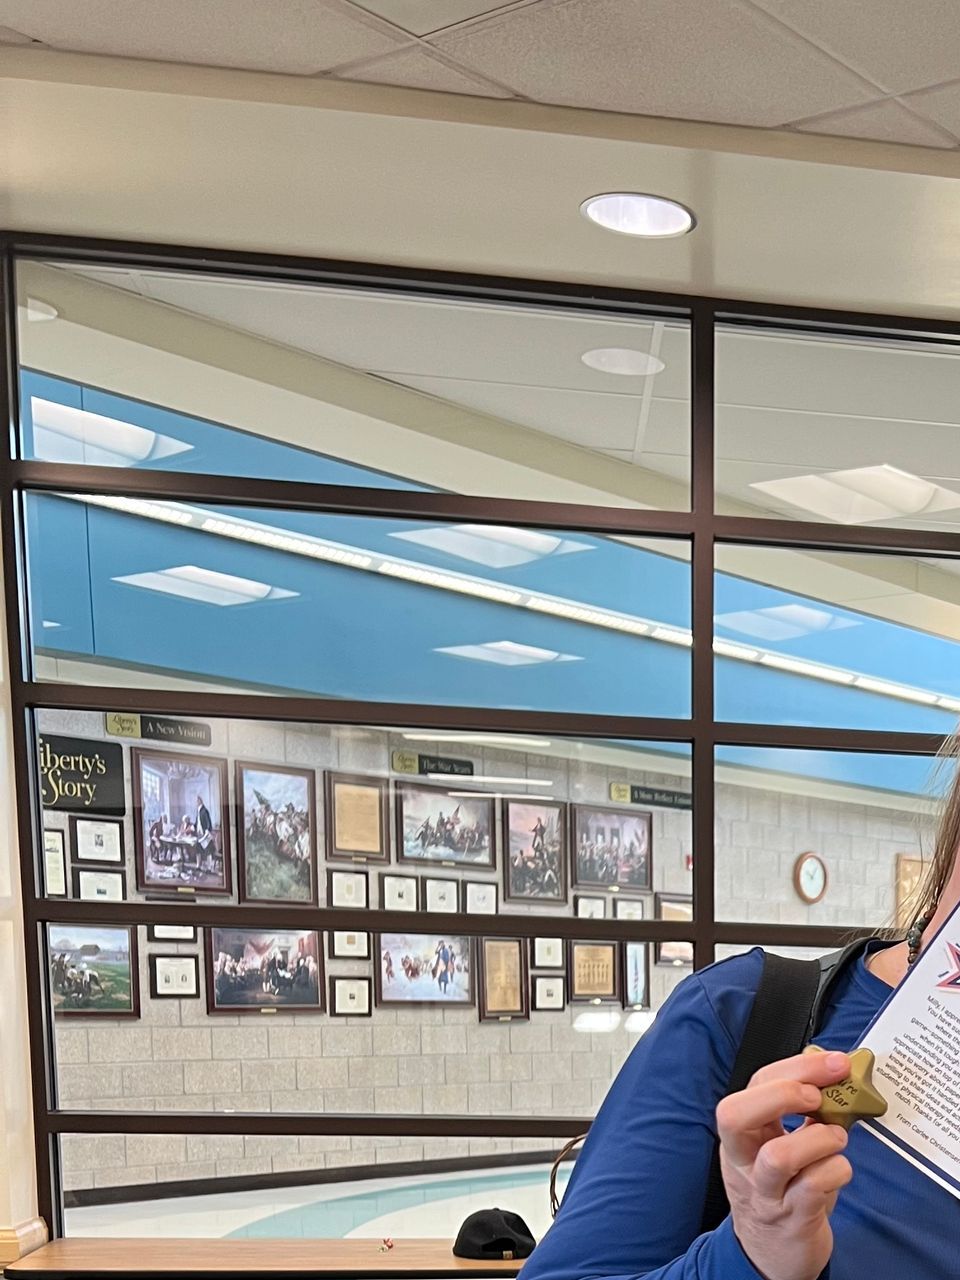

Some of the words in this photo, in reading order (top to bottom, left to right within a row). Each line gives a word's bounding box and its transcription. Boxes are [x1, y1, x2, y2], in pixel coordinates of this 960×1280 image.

[39, 738, 106, 780] iberty's
[42, 767, 97, 806] Story
[927, 1006, 938, 1017] You
[937, 1014, 951, 1027] have
[935, 1024, 952, 1038] where
[903, 1033, 942, 1063] understanding
[940, 1061, 953, 1071] you
[919, 1033, 935, 1047] when
[892, 1046, 907, 1059] have
[906, 1056, 913, 1064] to
[913, 1062, 929, 1075] worry
[928, 1073, 945, 1087] about
[893, 1036, 922, 1059] appreciate
[921, 1057, 934, 1068] how
[941, 1072, 952, 1082] top
[951, 1079, 960, 1087] of
[826, 1089, 848, 1107] Star
[884, 1062, 903, 1078] willing
[909, 1080, 925, 1094] share
[924, 1092, 940, 1105] ideas
[939, 1103, 952, 1114] and
[888, 1054, 904, 1067] know
[920, 1078, 932, 1088] got
[935, 1089, 959, 1108] handled
[900, 1085, 924, 1104] physical
[923, 1102, 945, 1119] therapy
[896, 1113, 911, 1127] From
[911, 1124, 929, 1140] Carlee
[929, 1138, 960, 1163] Christensen
[912, 1103, 932, 1121] Thanks
[932, 1118, 942, 1127] for
[940, 1125, 950, 1133] all
[947, 1131, 959, 1141] you
